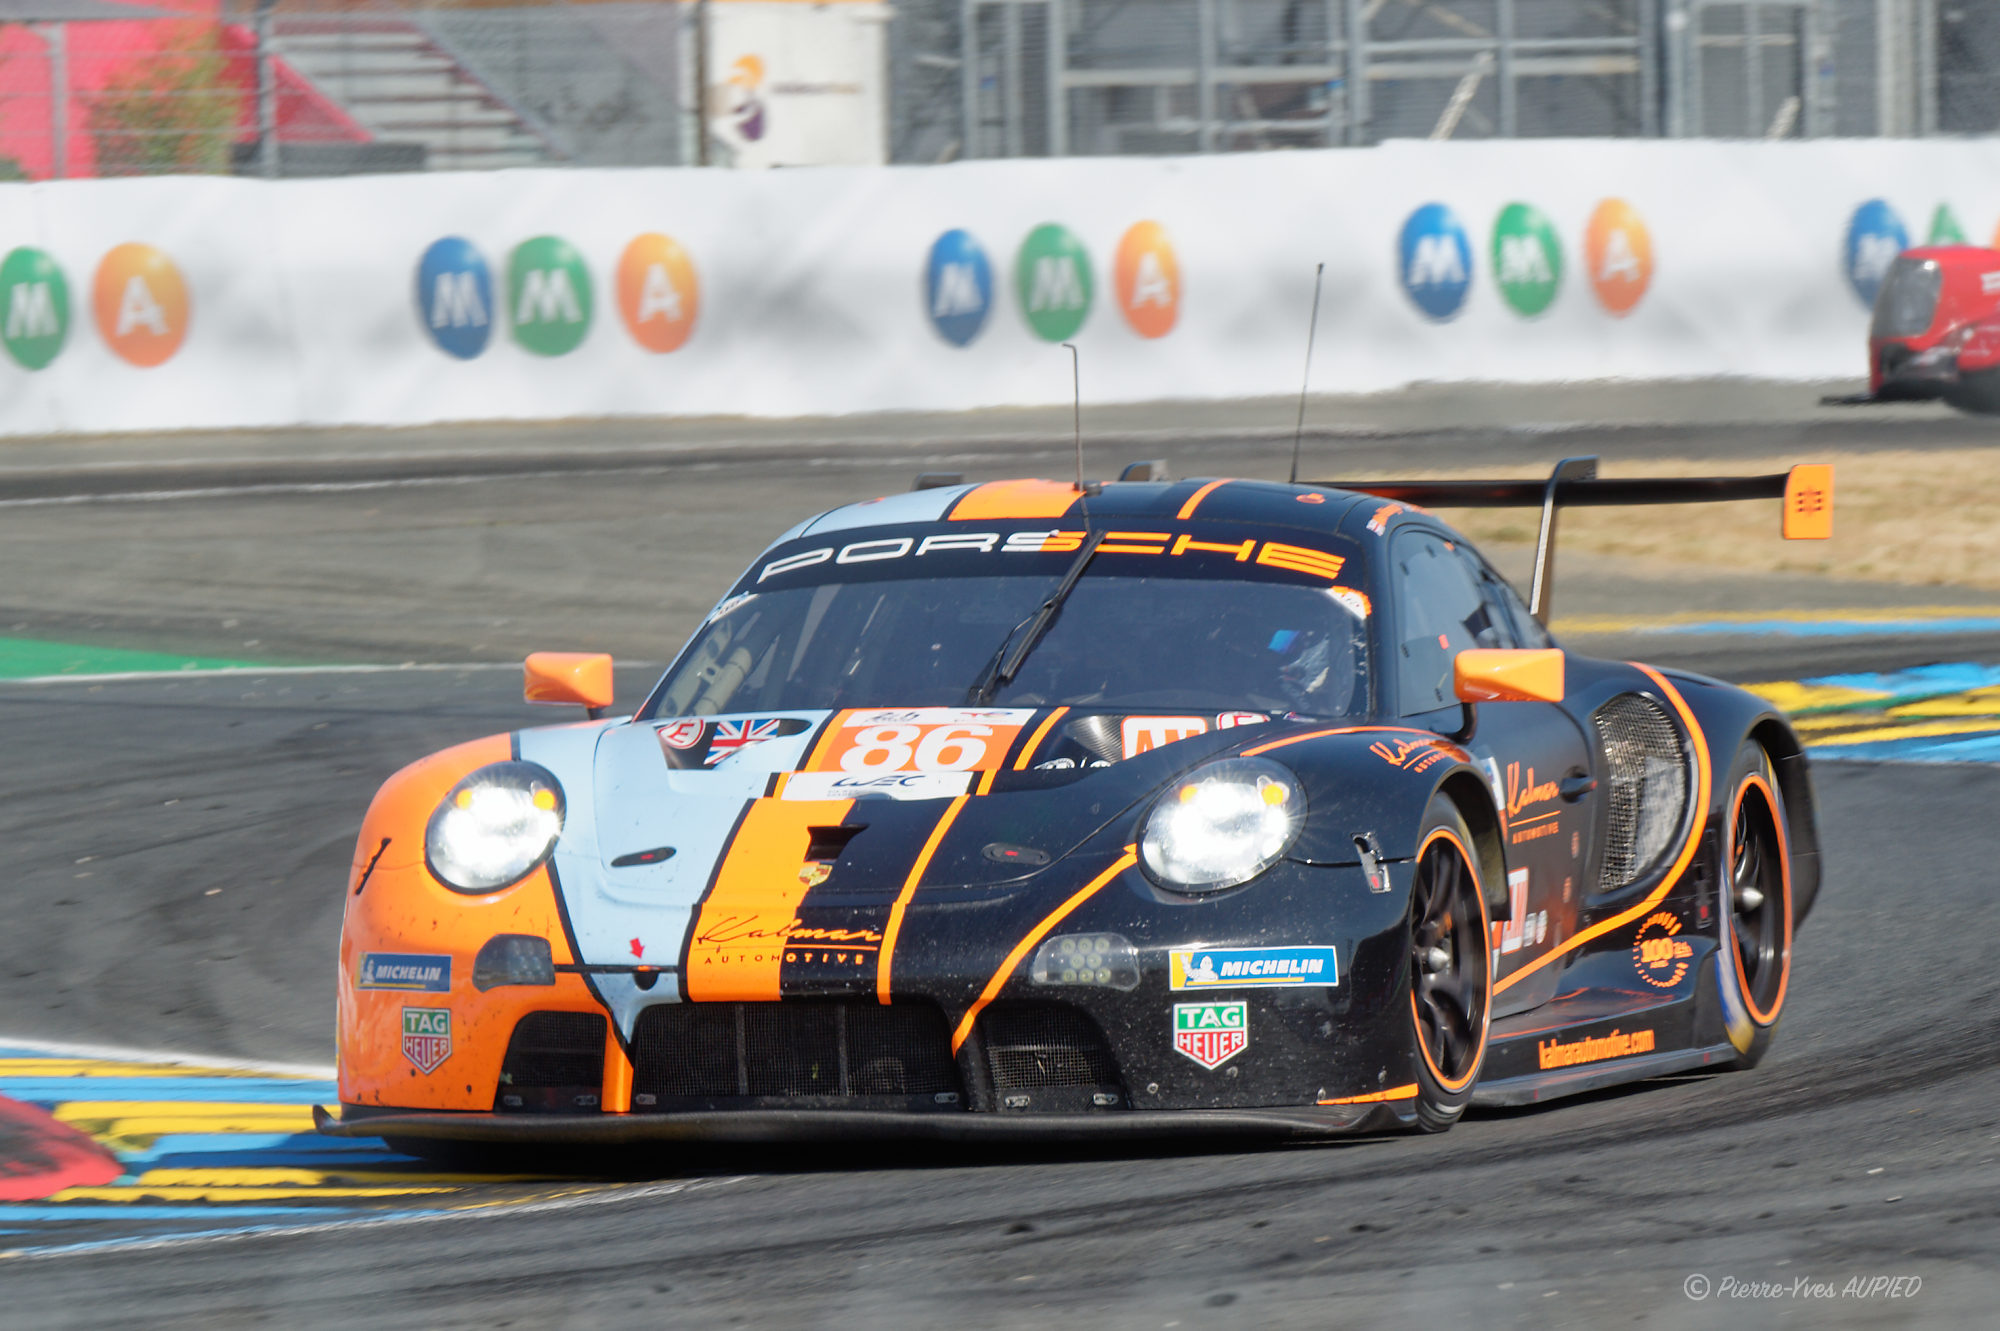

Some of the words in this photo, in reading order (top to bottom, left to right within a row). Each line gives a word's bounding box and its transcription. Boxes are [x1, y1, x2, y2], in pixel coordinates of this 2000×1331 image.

[757, 530, 1345, 584] PORSCHE
[839, 724, 994, 772] 86
[831, 775, 928, 788] WEC
[697, 915, 882, 942] Kalmar
[704, 952, 864, 965] AUTOMOTIVE
[1220, 958, 1324, 977] MICHELIN
[375, 965, 442, 981] MICHELIN
[406, 1012, 446, 1033] TAG
[1180, 1006, 1241, 1028] TAG
[405, 1037, 448, 1069] HEUER
[1177, 1032, 1243, 1064] HEUER
